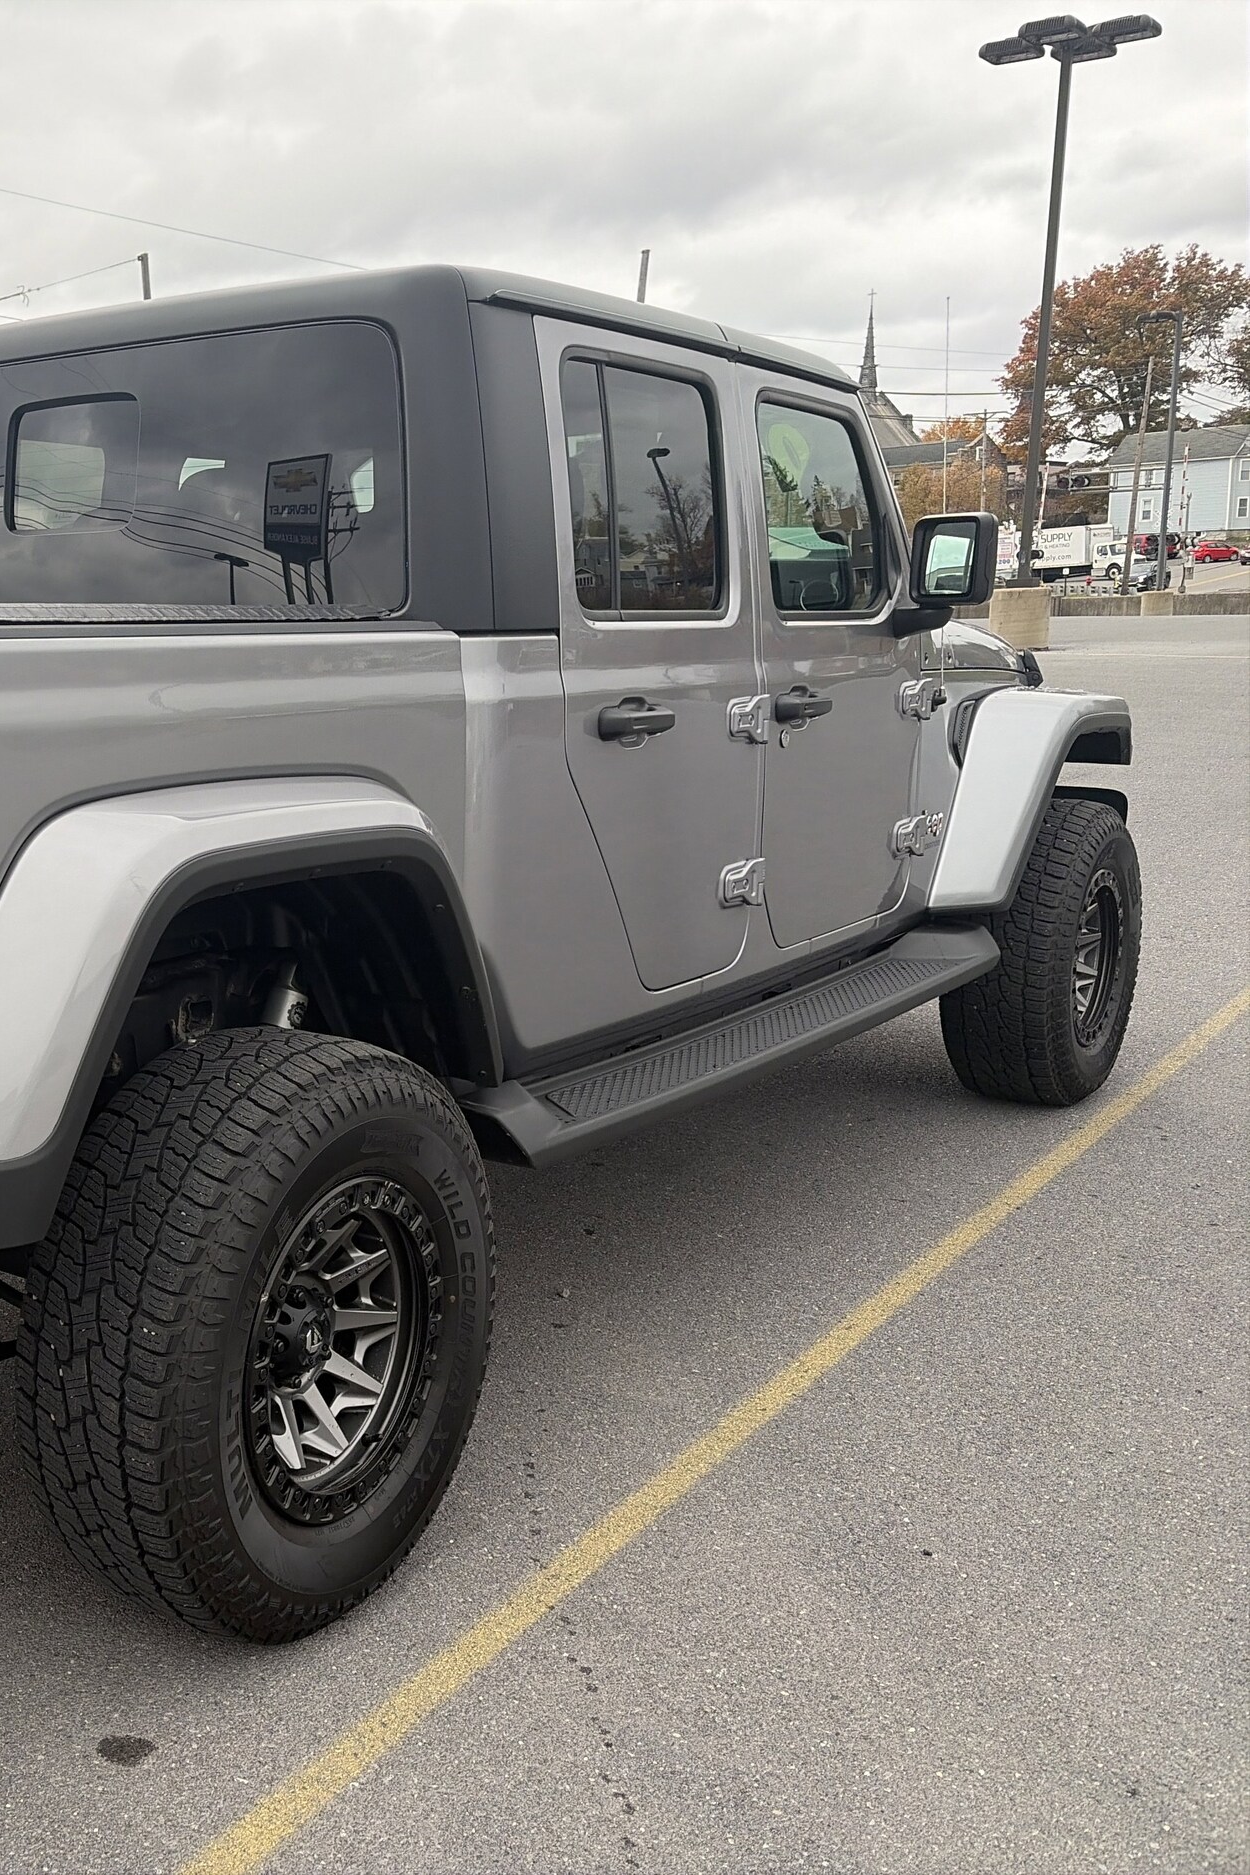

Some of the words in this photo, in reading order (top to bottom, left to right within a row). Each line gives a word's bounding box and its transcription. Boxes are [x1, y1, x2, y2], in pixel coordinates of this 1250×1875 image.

[1040, 532, 1073, 543] SUPPLY
[1040, 554, 1072, 562] pply.com
[433, 1168, 471, 1240] WILD
